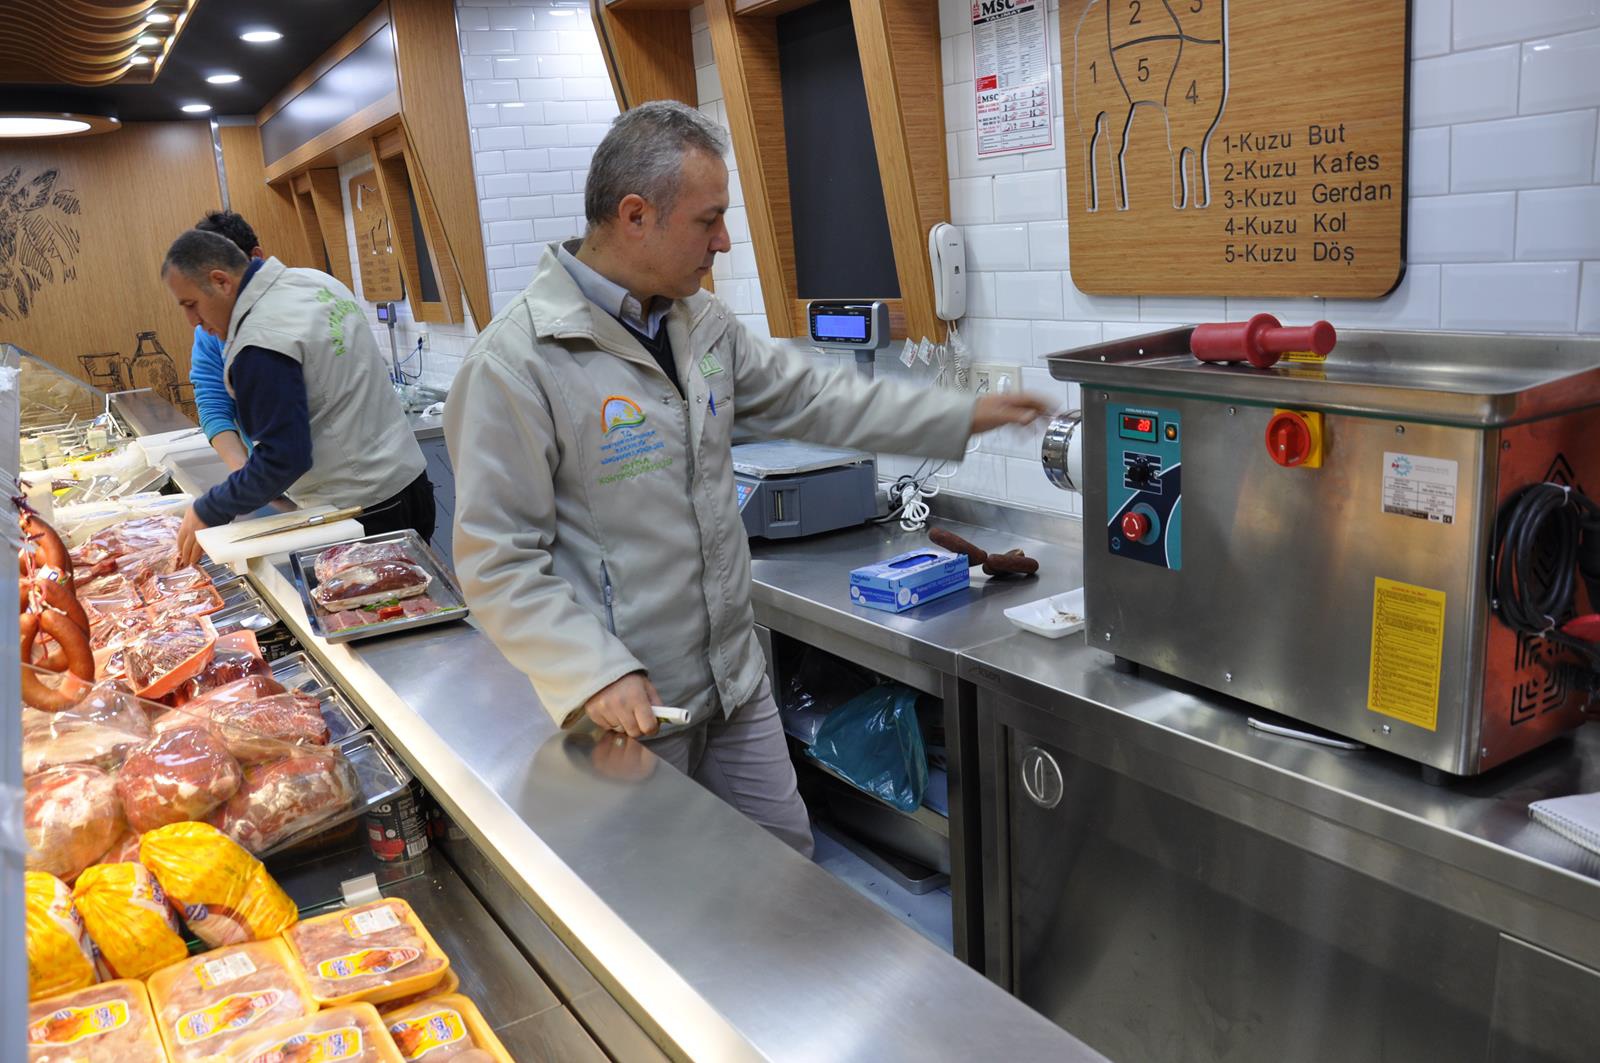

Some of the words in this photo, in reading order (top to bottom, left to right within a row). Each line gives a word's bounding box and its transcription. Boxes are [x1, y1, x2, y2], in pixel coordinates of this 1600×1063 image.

[982, 0, 1015, 16] MSC
[1129, 1, 1141, 25] 2
[1089, 61, 1097, 83] 1
[1137, 58, 1150, 82] 5
[982, 94, 999, 103] MSC
[1185, 80, 1199, 104] 4
[1222, 132, 1292, 153] 1-Kuzu
[1309, 123, 1345, 145] But
[1223, 160, 1296, 181] 2-Kuzu
[1313, 151, 1380, 174] Kafes
[1224, 188, 1296, 209] 3-Kuzu
[1312, 181, 1392, 204] Gerdan
[1224, 216, 1297, 235] 4-Kuzu
[1313, 212, 1346, 233] Kol
[1225, 243, 1297, 263] 5-Kuzu
[1313, 241, 1354, 266] Döş
